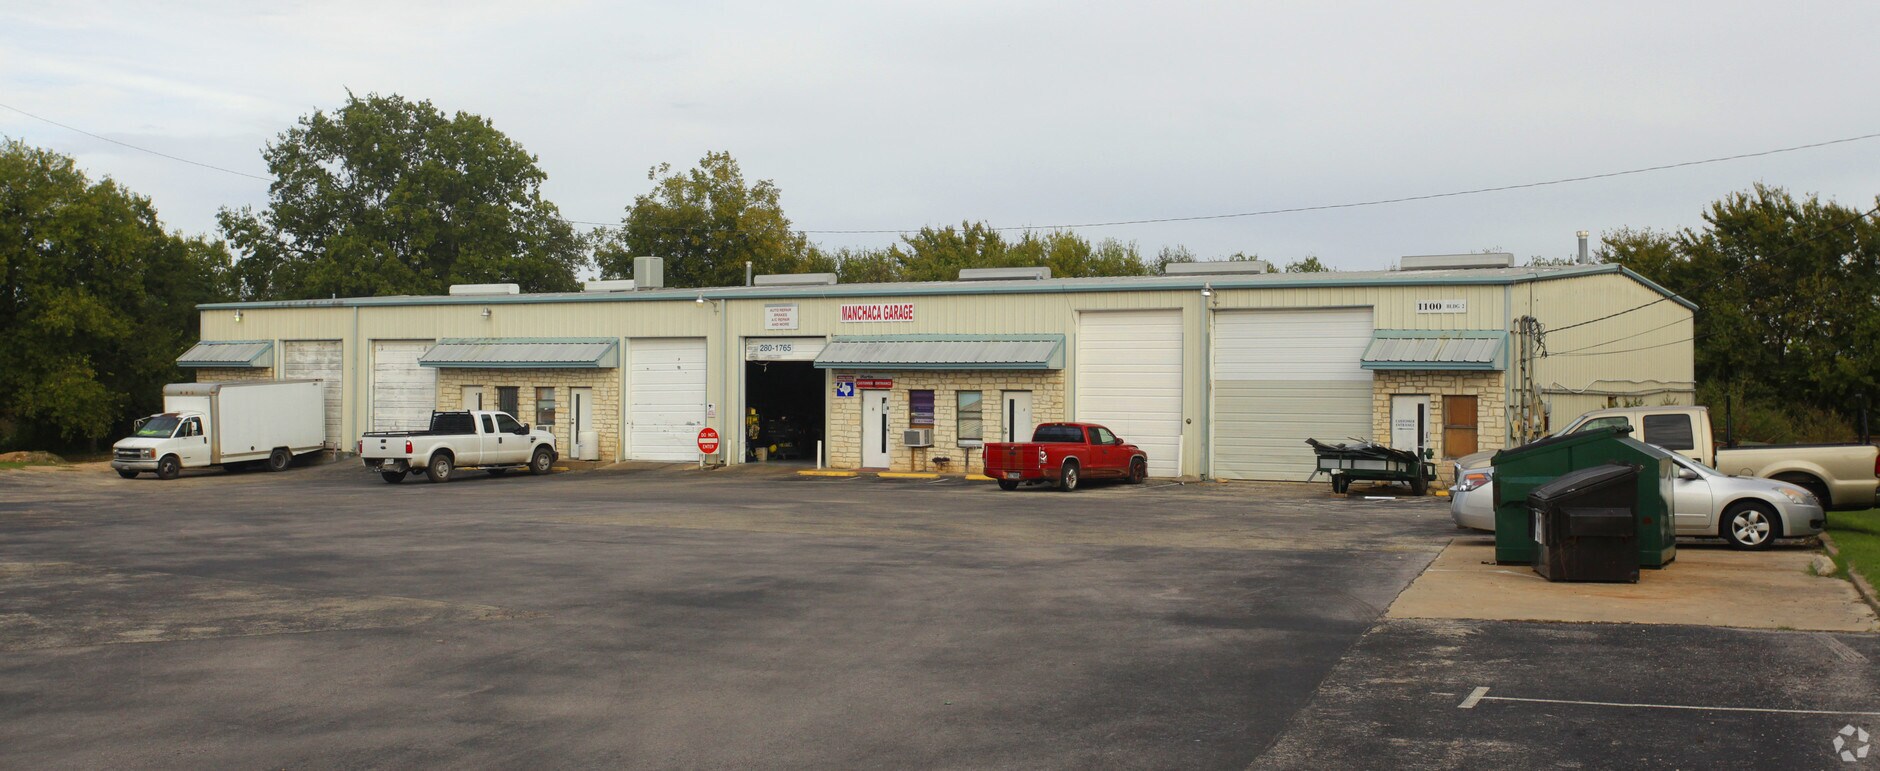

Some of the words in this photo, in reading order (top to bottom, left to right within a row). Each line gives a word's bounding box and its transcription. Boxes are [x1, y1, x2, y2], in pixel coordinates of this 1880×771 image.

[842, 305, 881, 321] MANCHACA
[883, 304, 913, 320] GARAGE
[760, 344, 792, 352] 280-1765
